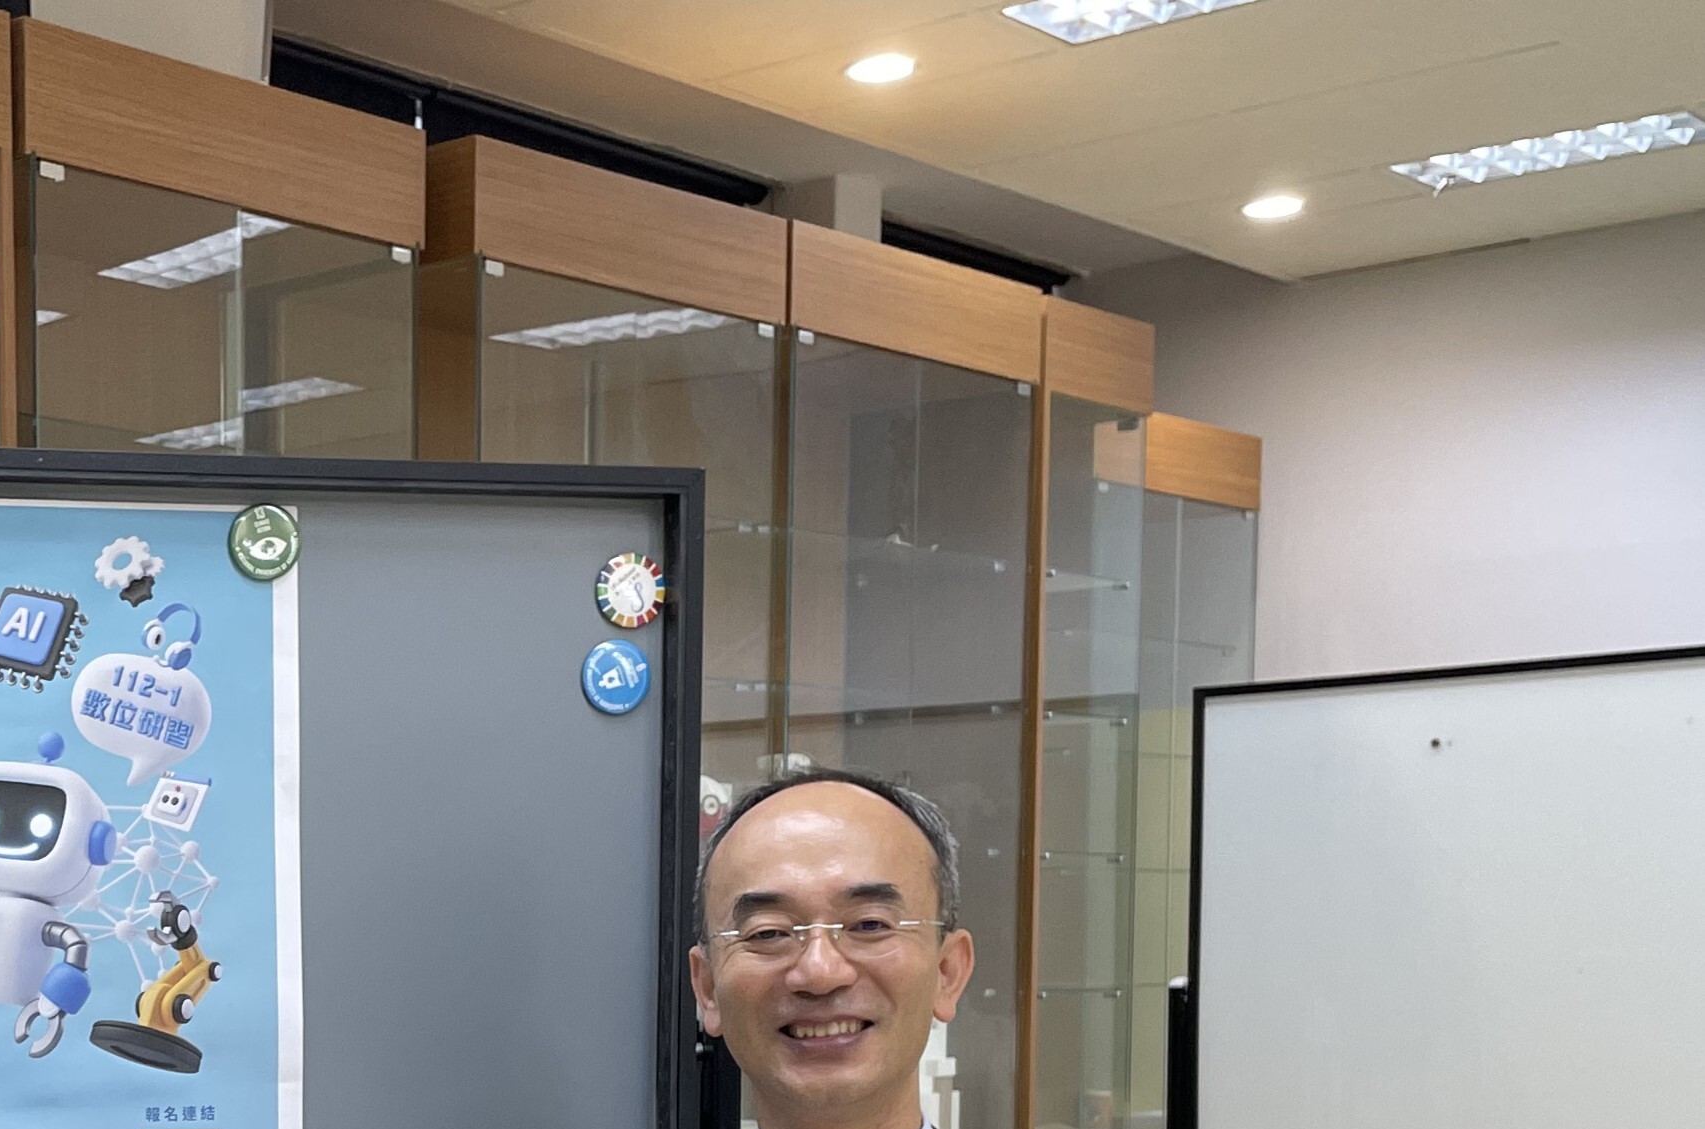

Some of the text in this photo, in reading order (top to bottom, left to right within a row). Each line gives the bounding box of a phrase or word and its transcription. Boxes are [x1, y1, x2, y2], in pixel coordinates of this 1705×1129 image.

[1, 607, 46, 642] AI
[113, 665, 183, 707] 112-1
[80, 687, 195, 750] 數位研習
[145, 1104, 216, 1123] 報名連結
